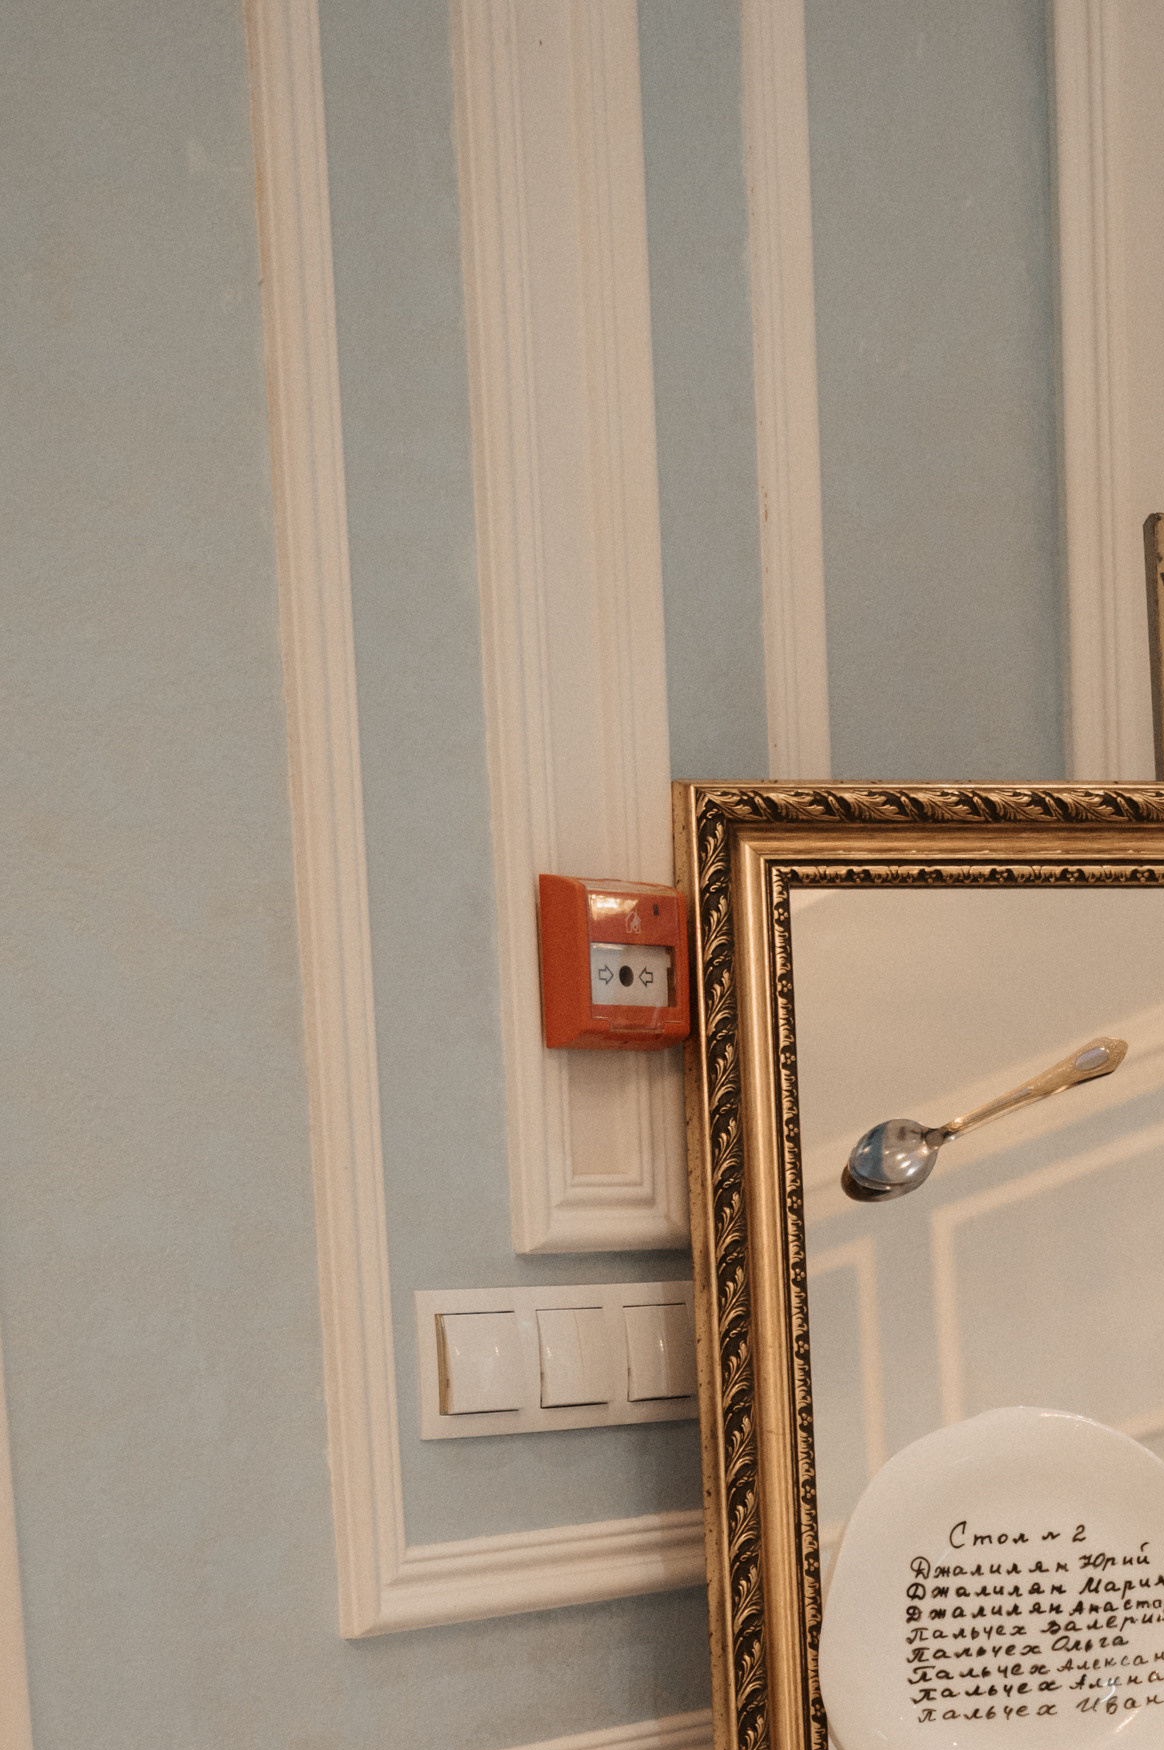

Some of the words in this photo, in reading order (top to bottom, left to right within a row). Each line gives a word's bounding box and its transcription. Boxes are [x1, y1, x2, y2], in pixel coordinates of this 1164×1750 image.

[949, 1521, 1029, 1548] Стол
[1072, 1524, 1087, 1543] 2
[910, 1556, 1070, 1580] Джалилян
[1079, 1542, 1151, 1570] Юрий
[906, 1582, 1066, 1600] Джалилян
[906, 1601, 1064, 1623] Джалилян
[906, 1623, 1027, 1644] Пальчех
[906, 1642, 1041, 1663] Пальчех
[1051, 1636, 1129, 1653] Ольга
[908, 1662, 1050, 1685] Пальчех
[910, 1679, 1063, 1705] Пальчех
[918, 1703, 1057, 1723] Пальчех
[1076, 1693, 1164, 1714] Иван
